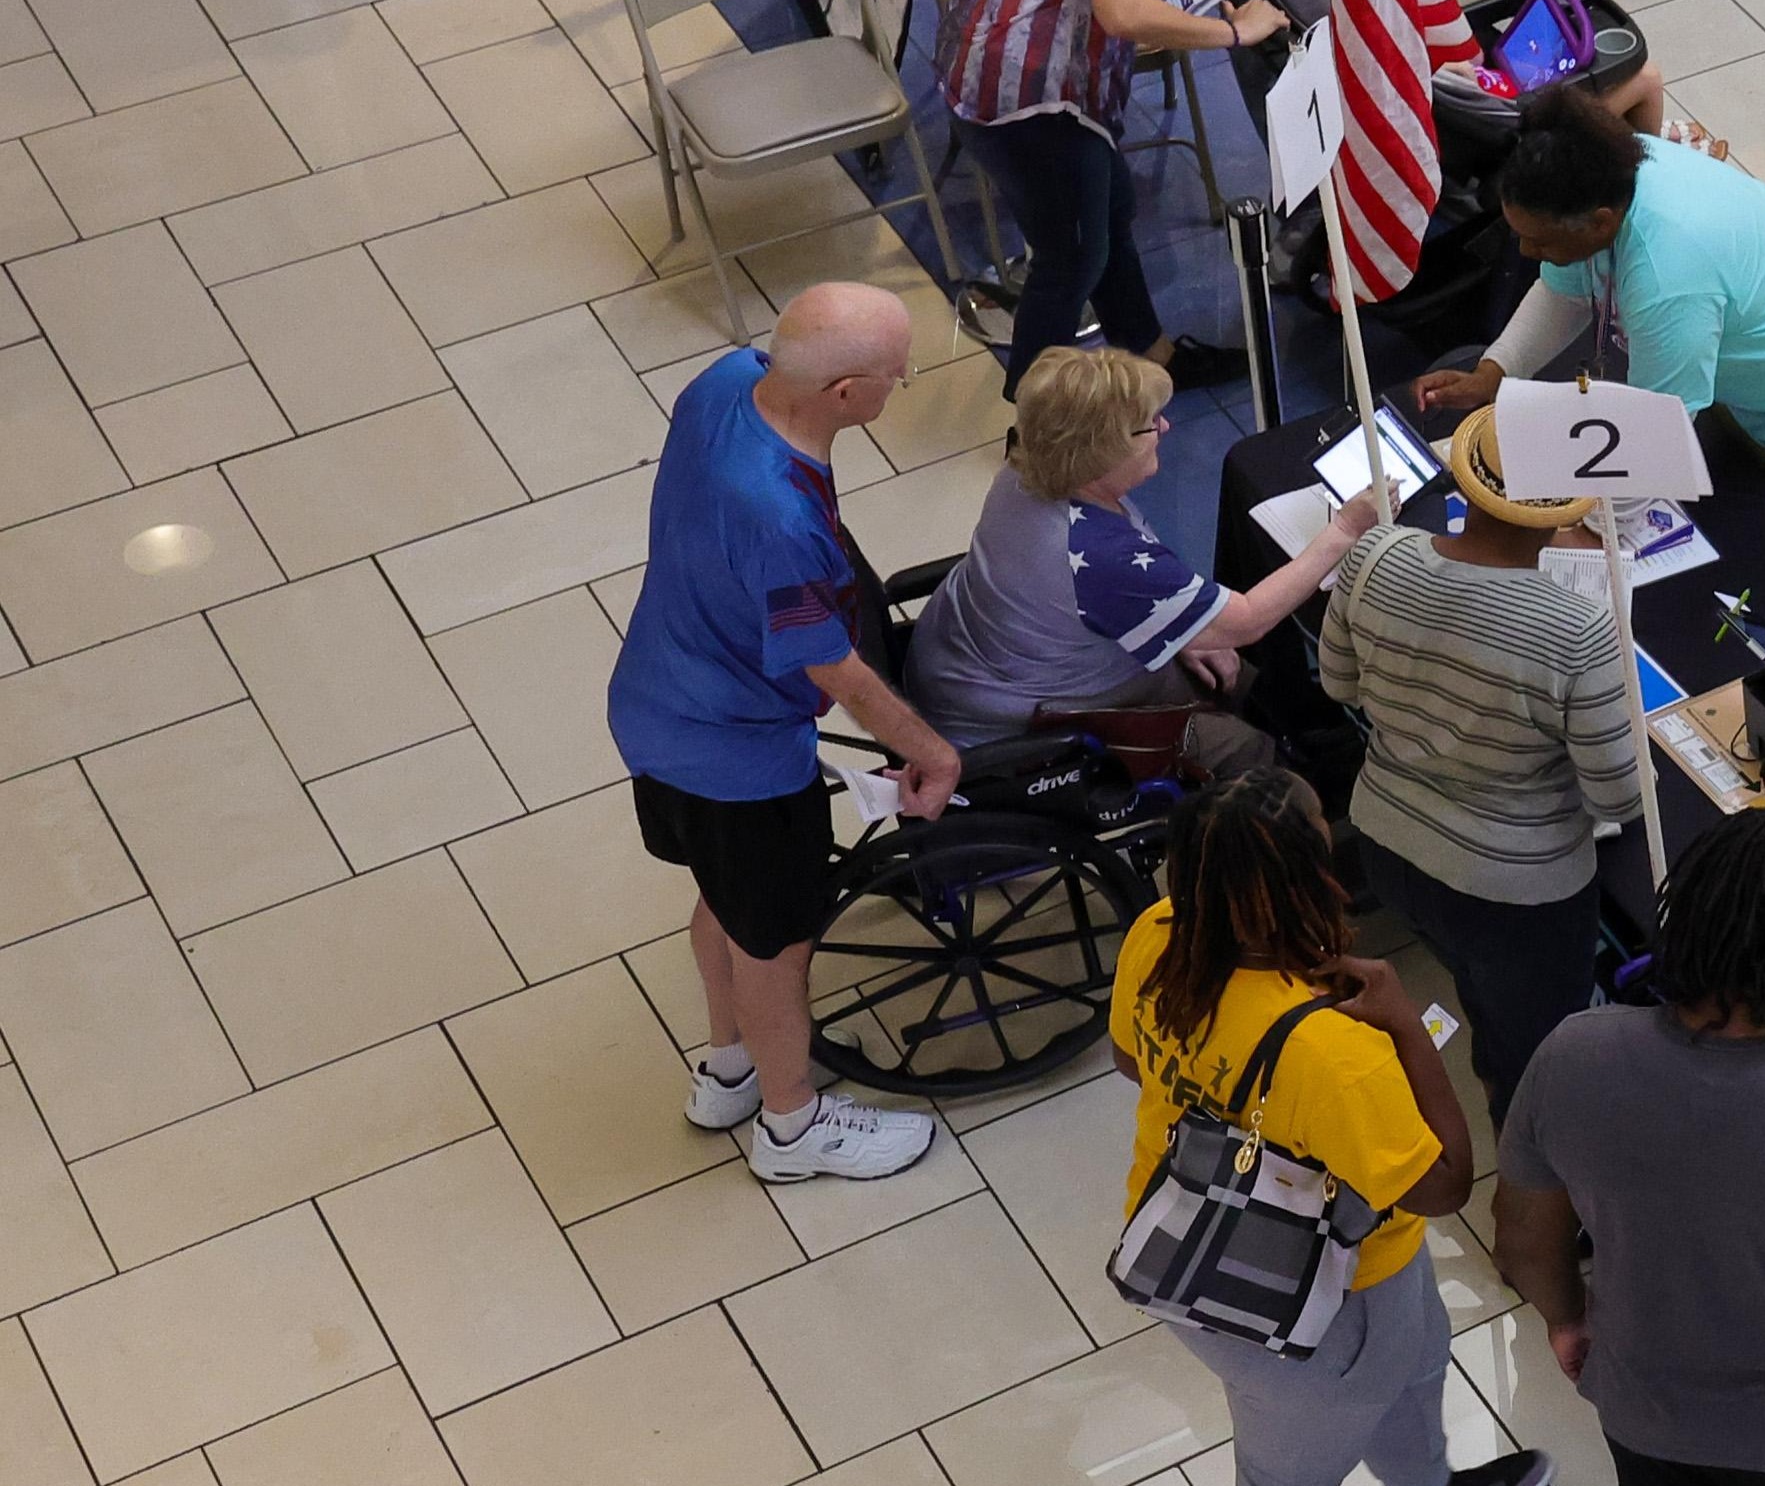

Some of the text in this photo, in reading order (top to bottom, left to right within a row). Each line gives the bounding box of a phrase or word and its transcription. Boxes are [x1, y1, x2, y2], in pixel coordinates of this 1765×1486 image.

[1307, 87, 1326, 155] 1
[1569, 418, 1629, 479] 2
[1027, 769, 1081, 796] drive
